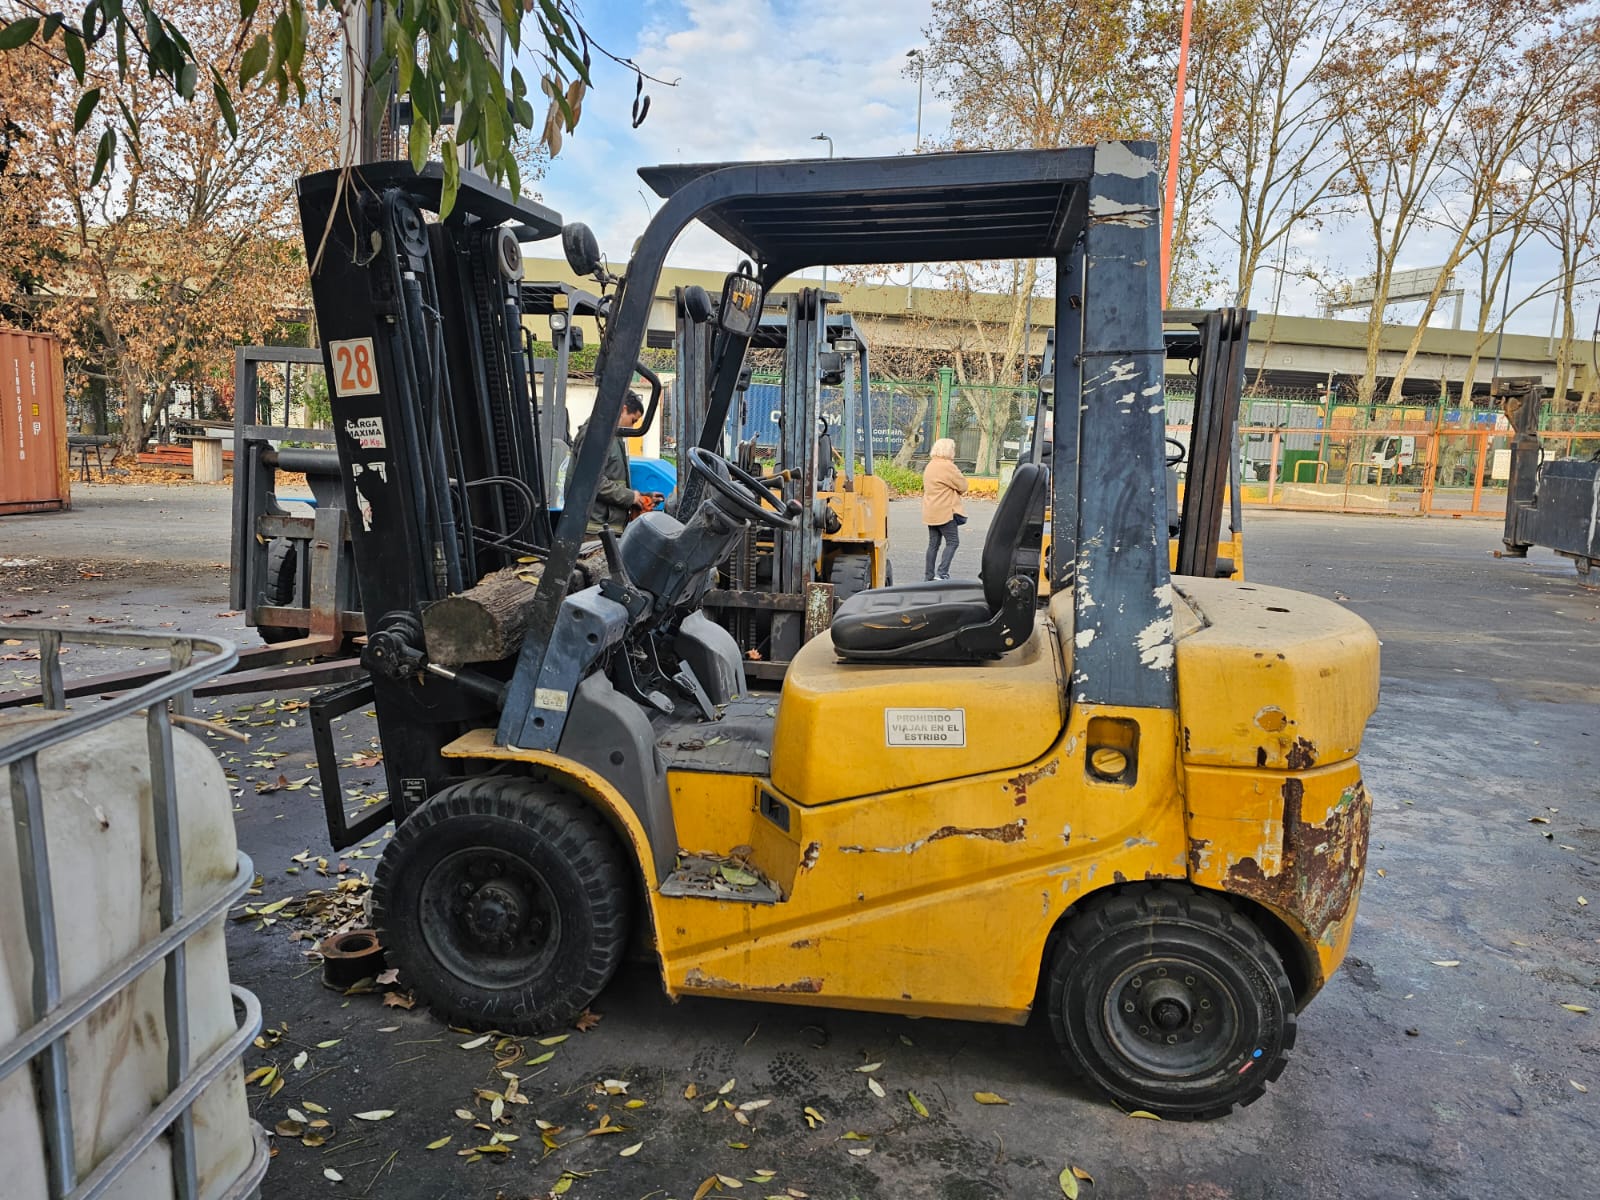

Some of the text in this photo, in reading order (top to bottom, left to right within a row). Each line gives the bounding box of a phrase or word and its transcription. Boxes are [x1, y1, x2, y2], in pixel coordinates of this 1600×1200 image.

[337, 345, 372, 390] 28
[348, 420, 378, 429] CARGA
[896, 714, 951, 722] PROHIBIDO
[892, 724, 960, 732] VIAJAR EN EL
[904, 733, 948, 741] ESTRIBO
